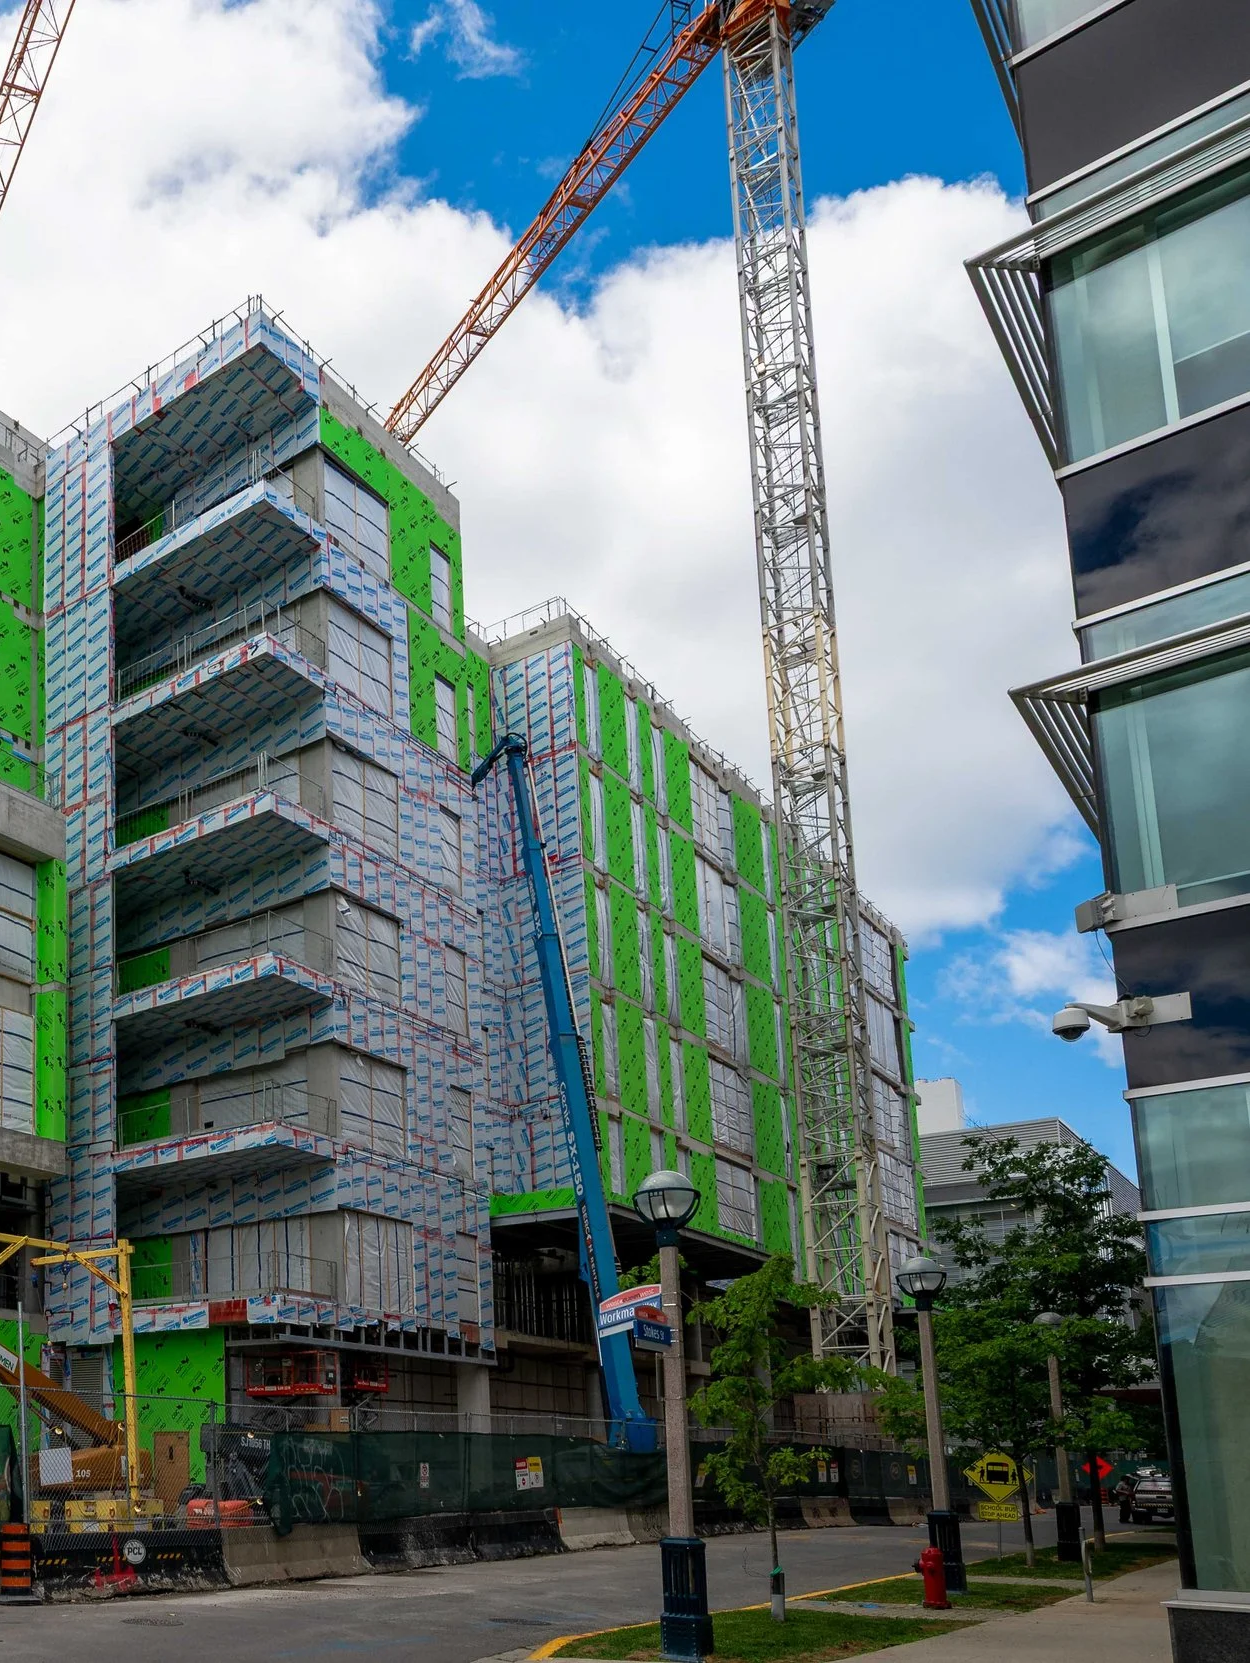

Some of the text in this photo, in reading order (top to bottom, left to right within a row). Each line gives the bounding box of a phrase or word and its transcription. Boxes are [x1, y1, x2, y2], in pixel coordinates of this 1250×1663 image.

[559, 1081, 584, 1197] Genie SX-150
[589, 1256, 600, 1298] RENTALS
[599, 1307, 634, 1326] Workma
[643, 1324, 659, 1339] Stokes
[127, 1546, 142, 1556] PCL
